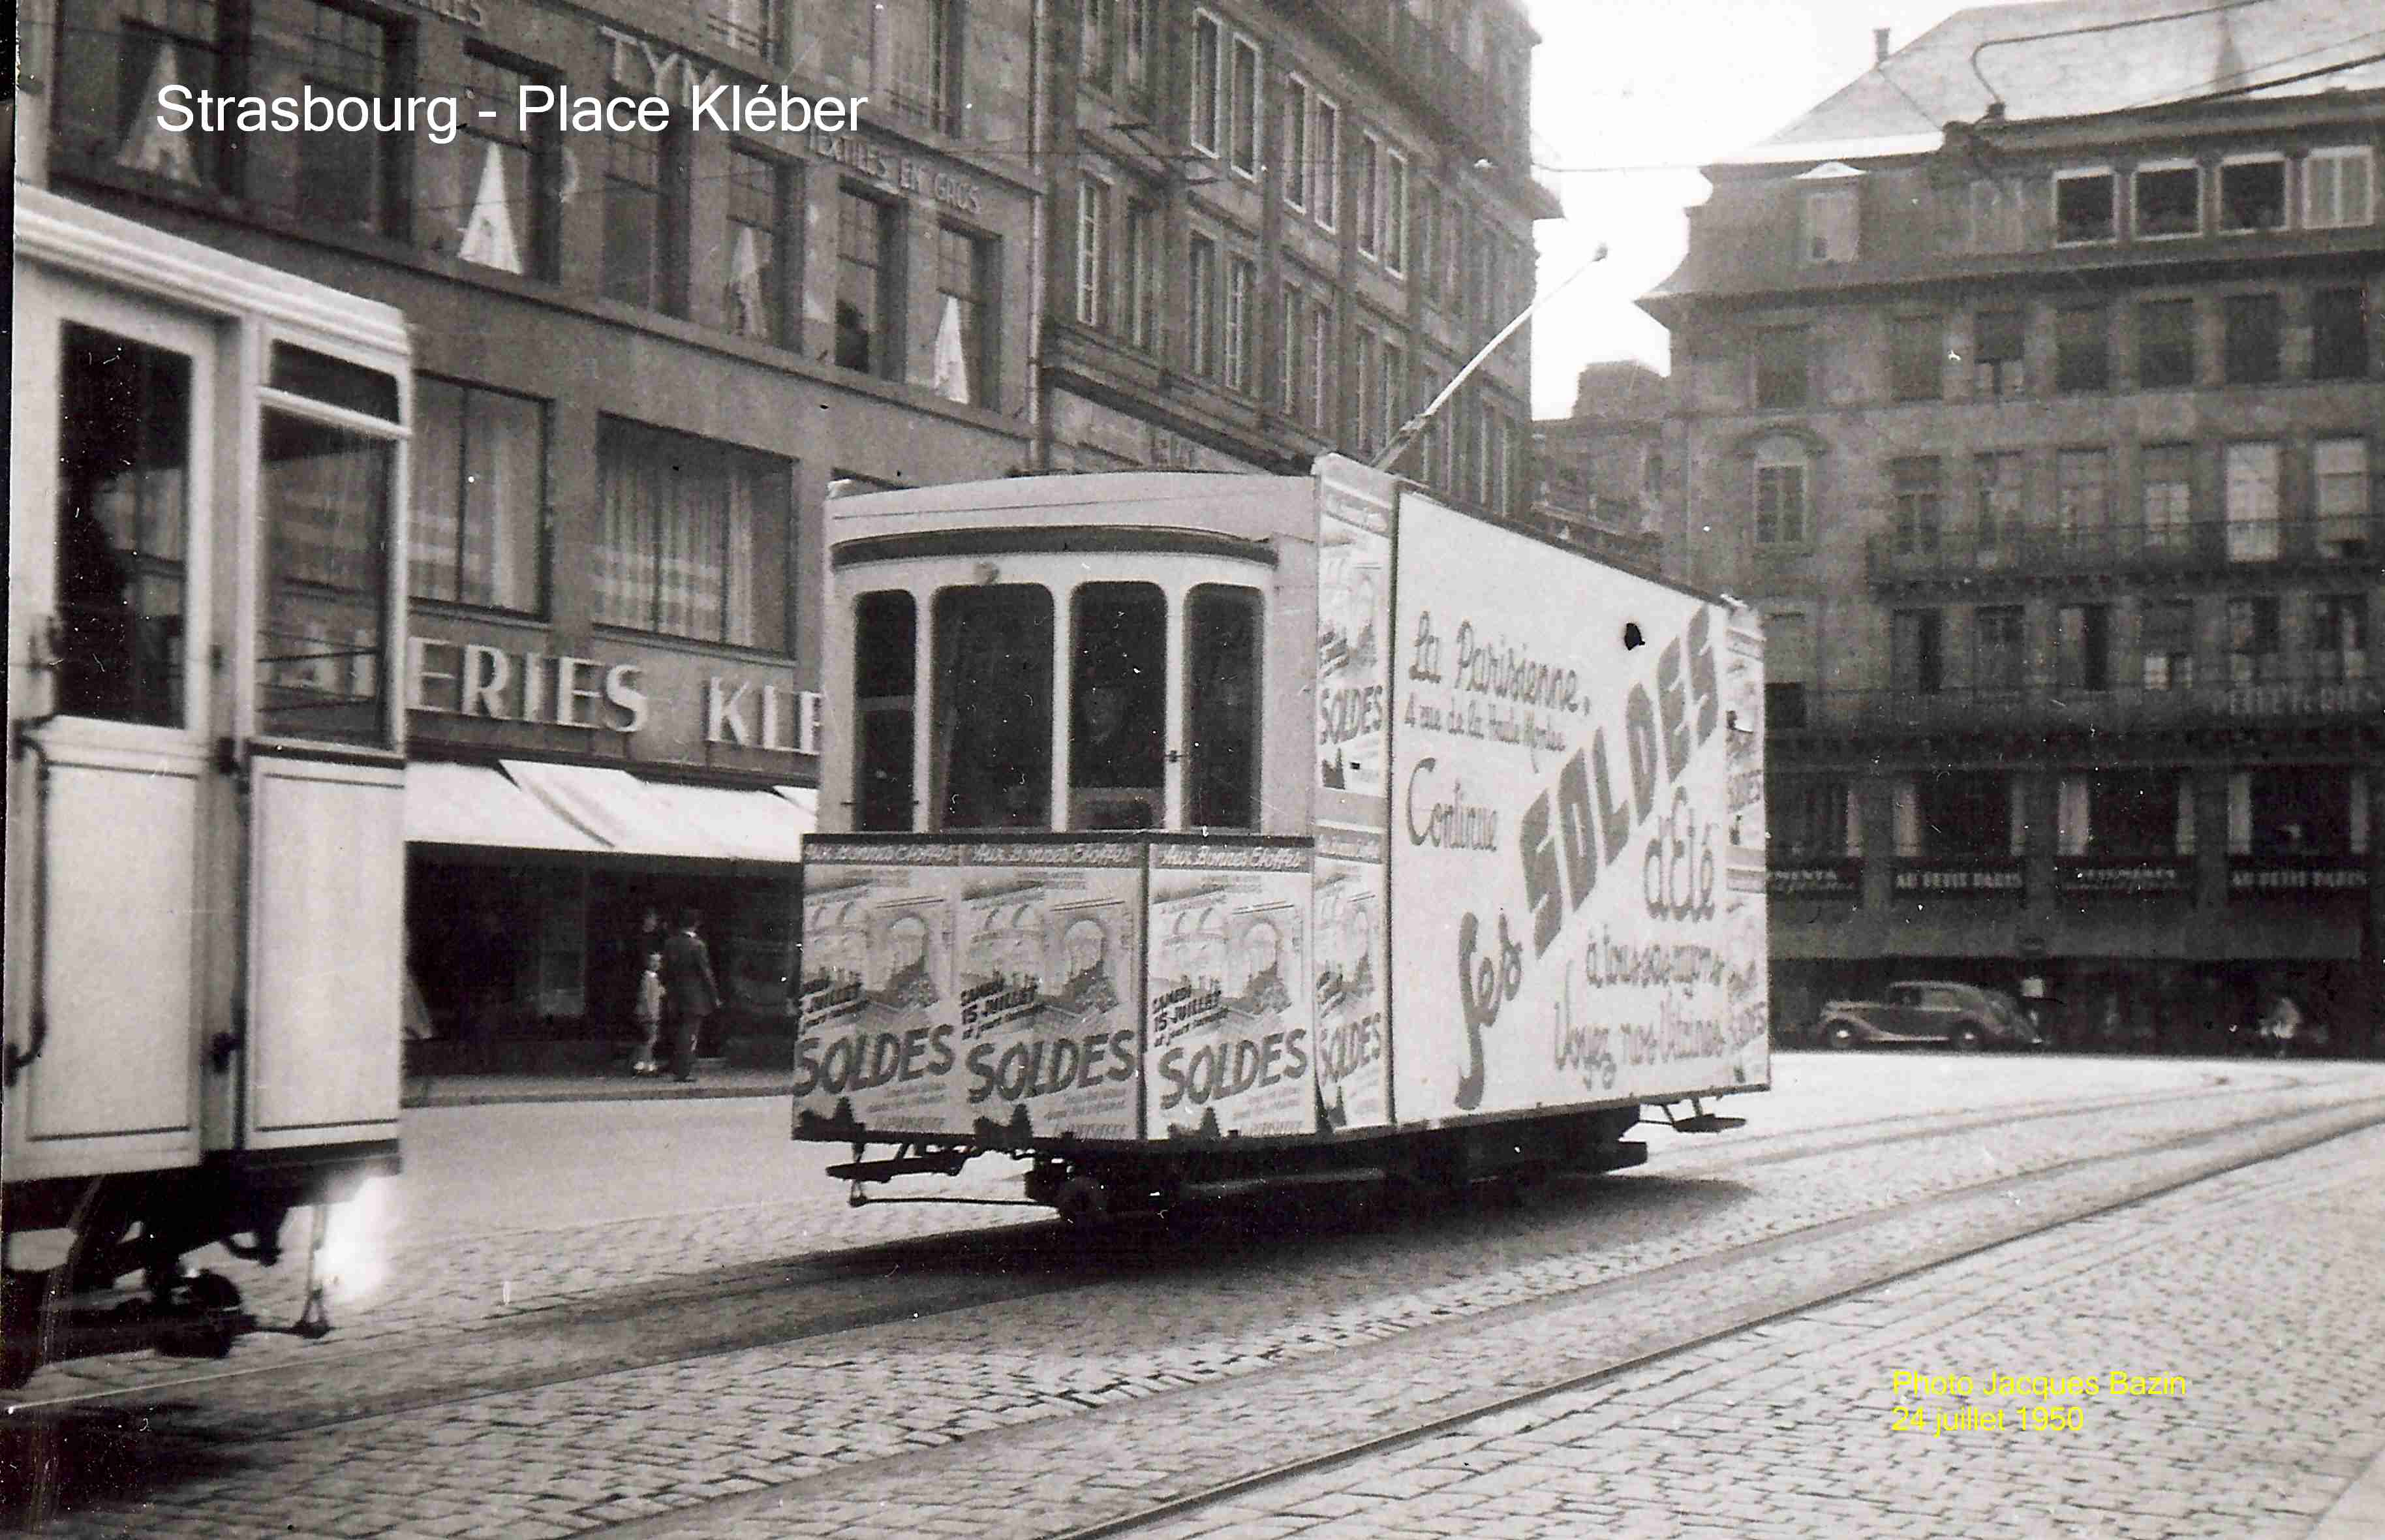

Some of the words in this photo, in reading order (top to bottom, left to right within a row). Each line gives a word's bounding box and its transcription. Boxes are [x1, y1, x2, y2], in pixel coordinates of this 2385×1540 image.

[1317, 685, 1383, 746] SOLDES
[1519, 604, 1719, 959] SOLDES
[1154, 1011, 1168, 1032] 15
[792, 1023, 957, 1097] SOLDES
[965, 1029, 1137, 1104] SOLDES
[1158, 1028, 1308, 1110] SOLDES
